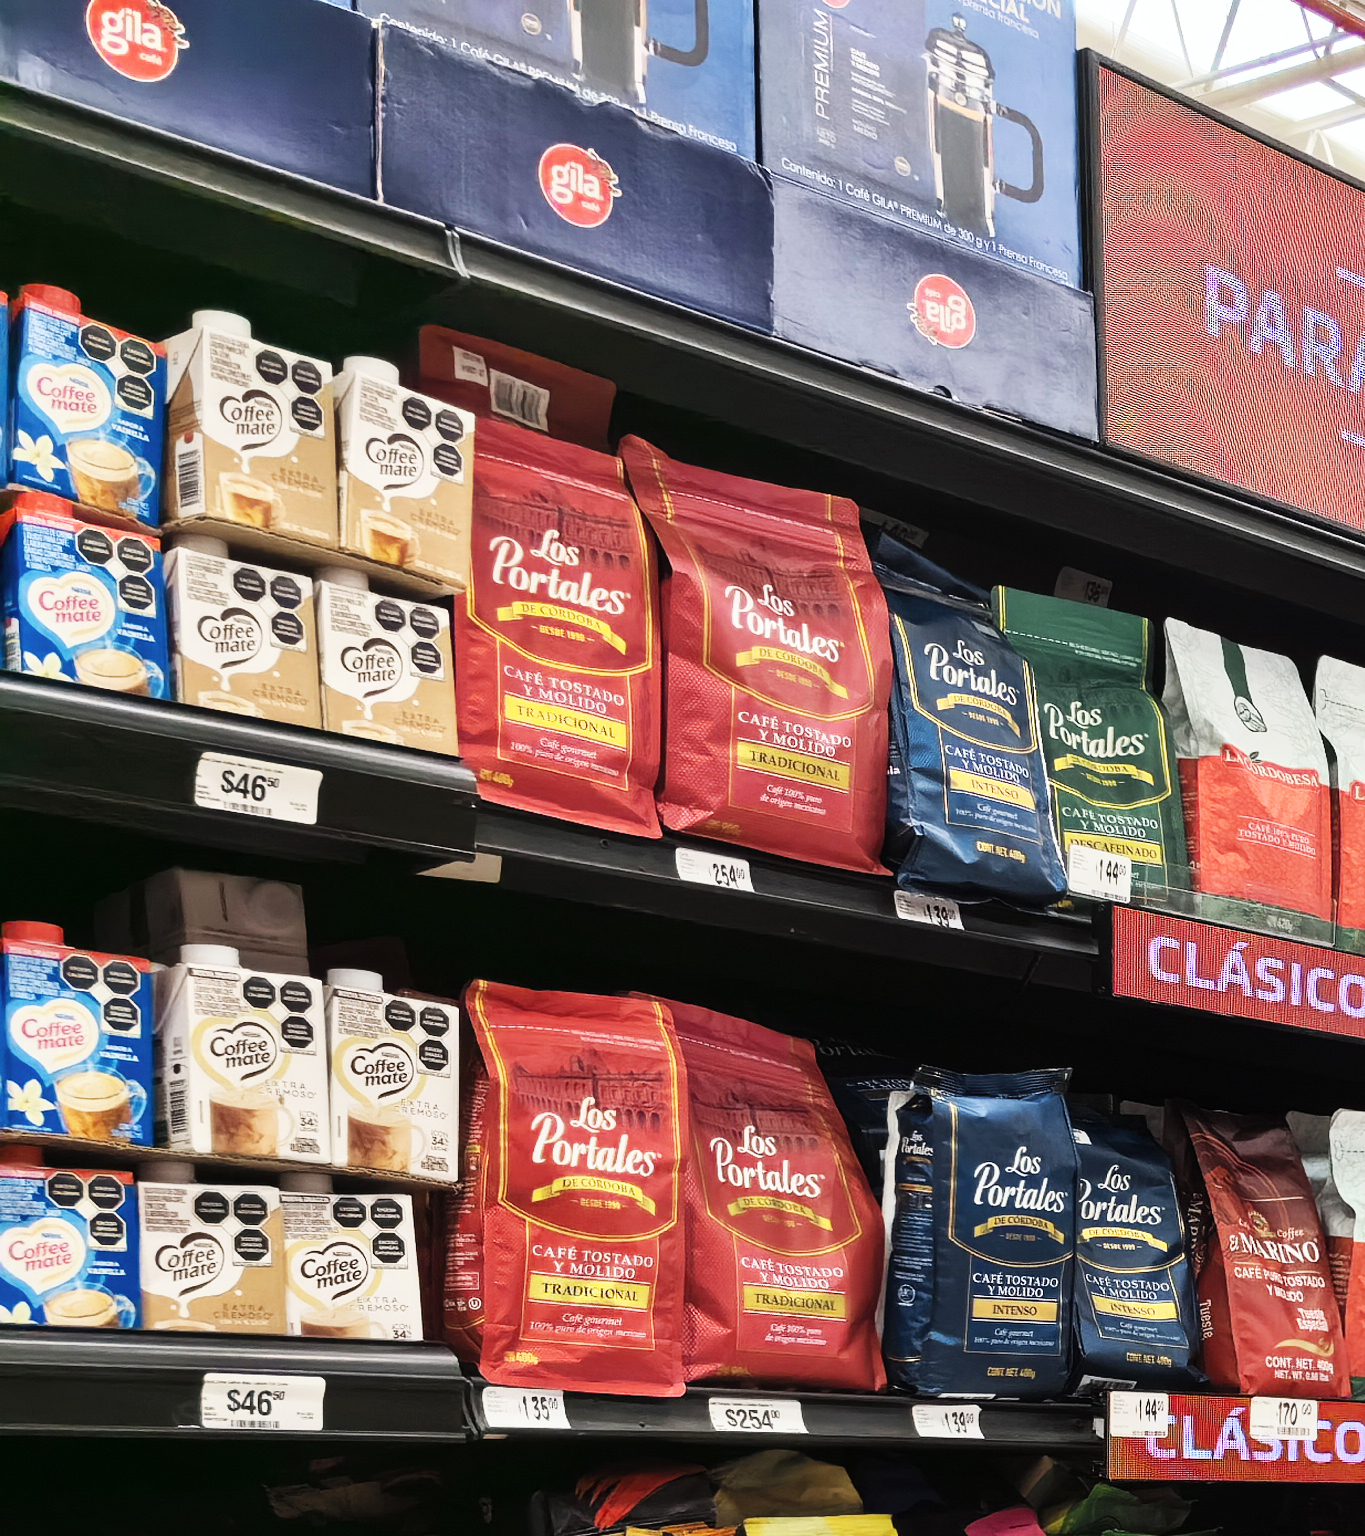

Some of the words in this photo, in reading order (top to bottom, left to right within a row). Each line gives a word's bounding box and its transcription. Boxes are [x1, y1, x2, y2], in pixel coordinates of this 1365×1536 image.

[100, 6, 162, 54] gila
[813, 8, 829, 120] PREMIUM
[549, 159, 601, 199] gila
[782, 157, 835, 188] Contenido:
[845, 183, 869, 201] Café
[900, 205, 942, 231] PREMIUM
[998, 243, 1027, 265] Prensa
[1029, 254, 1068, 280] Francesa
[36, 375, 96, 406] Coffee
[51, 395, 99, 416] mate
[532, 529, 580, 567] Los
[489, 536, 626, 615] Portales
[504, 662, 546, 687] CAFÉ
[552, 672, 626, 706] TOSTADO
[523, 683, 535, 698] Y
[540, 685, 607, 714] MOLIDO
[516, 704, 616, 739] TRADICIONAL
[1239, 1232, 1321, 1265] MARINO
